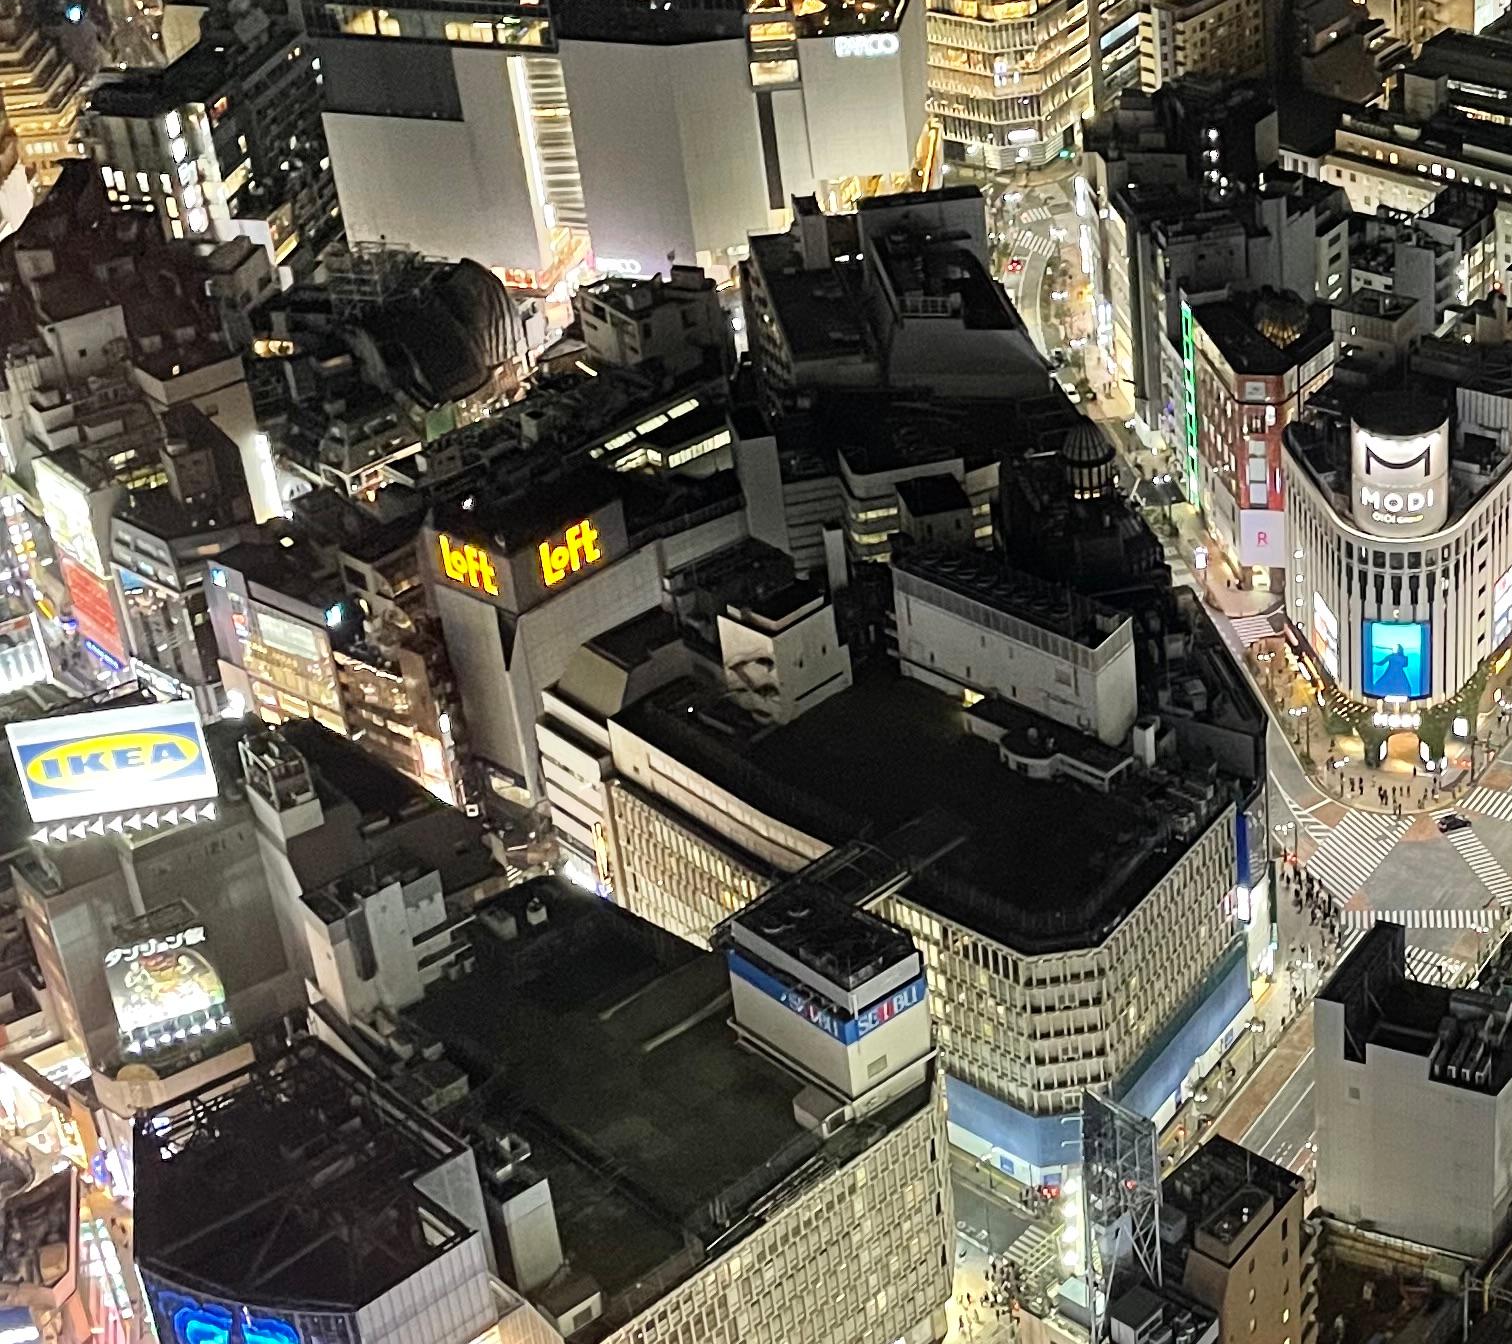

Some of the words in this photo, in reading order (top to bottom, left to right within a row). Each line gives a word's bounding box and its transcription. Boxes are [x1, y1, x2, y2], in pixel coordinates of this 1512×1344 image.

[1361, 486, 1434, 513] MODI
[41, 742, 188, 780] IKEA
[858, 986, 917, 1035] SEIBU
